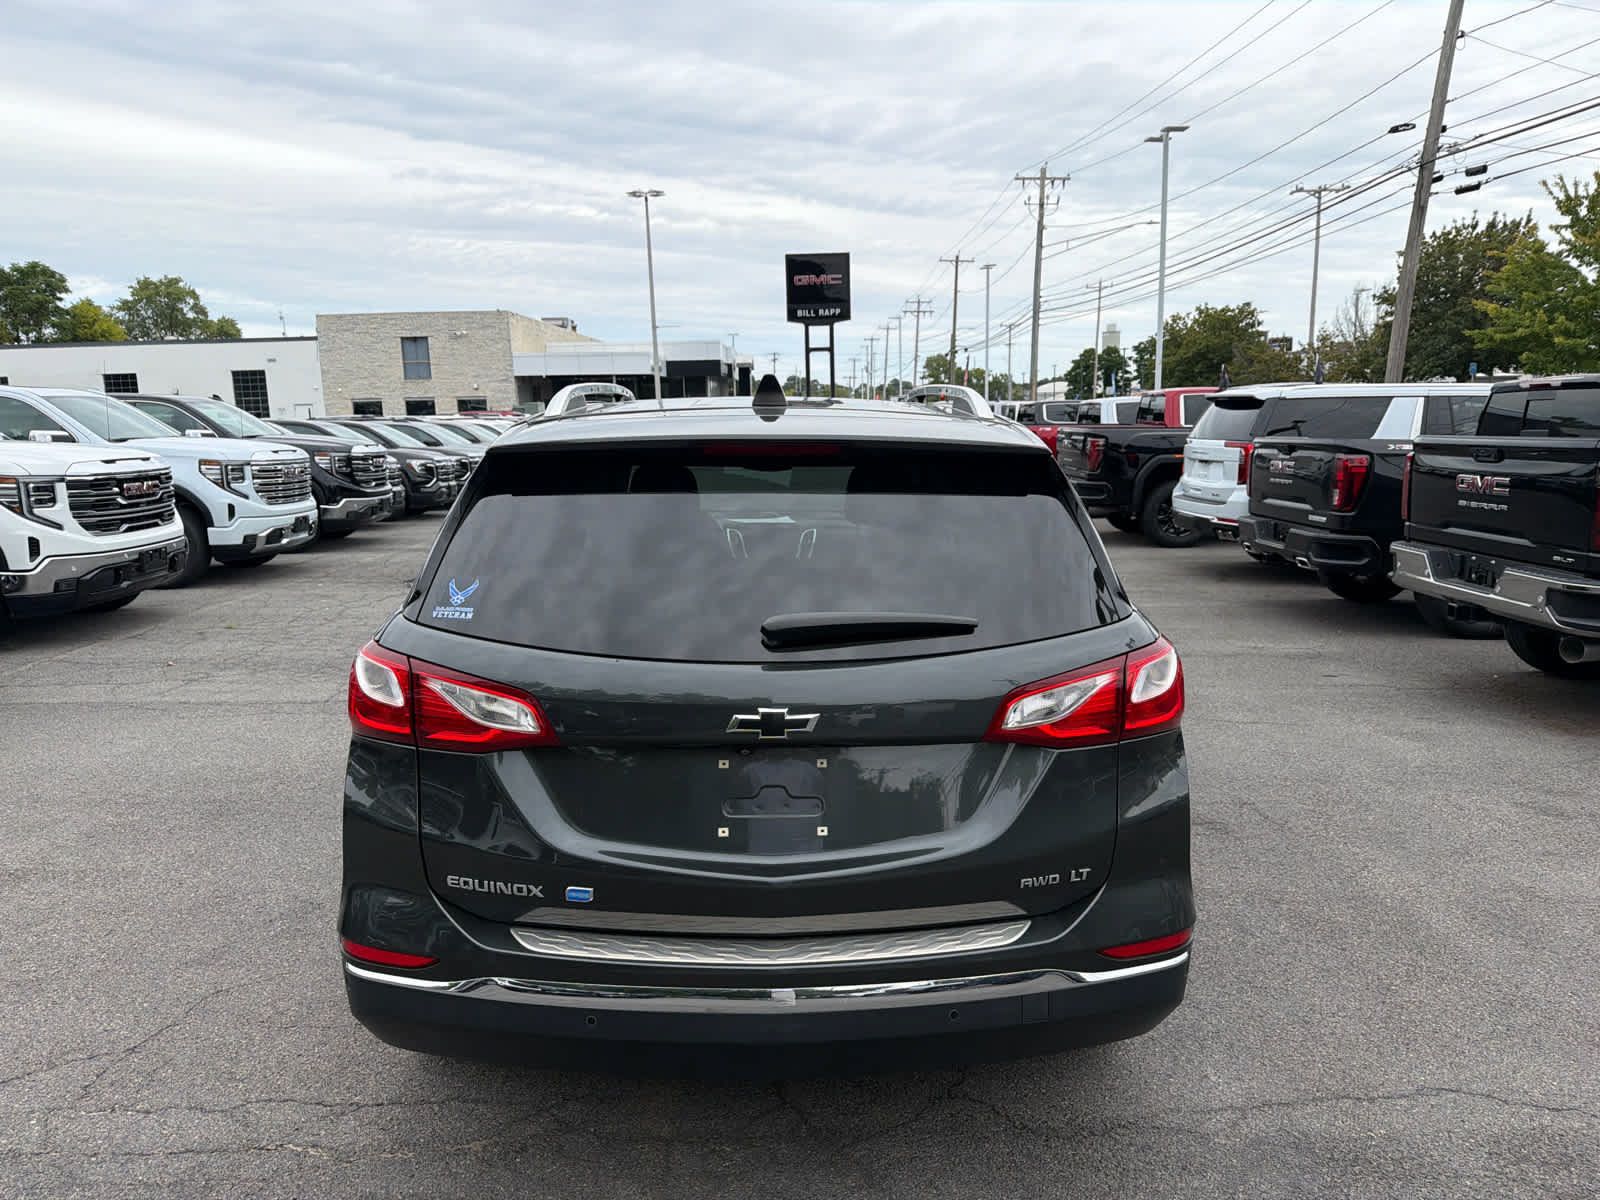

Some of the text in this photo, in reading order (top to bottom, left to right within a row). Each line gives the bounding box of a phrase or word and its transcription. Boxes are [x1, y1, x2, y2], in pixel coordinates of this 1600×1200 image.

[793, 274, 842, 286] GMC
[797, 308, 841, 317] BILL RAPP
[1456, 474, 1511, 496] GMC
[432, 610, 474, 619] VETERAN
[446, 875, 545, 898] EQUINOX
[1020, 868, 1092, 889] AWD LT
